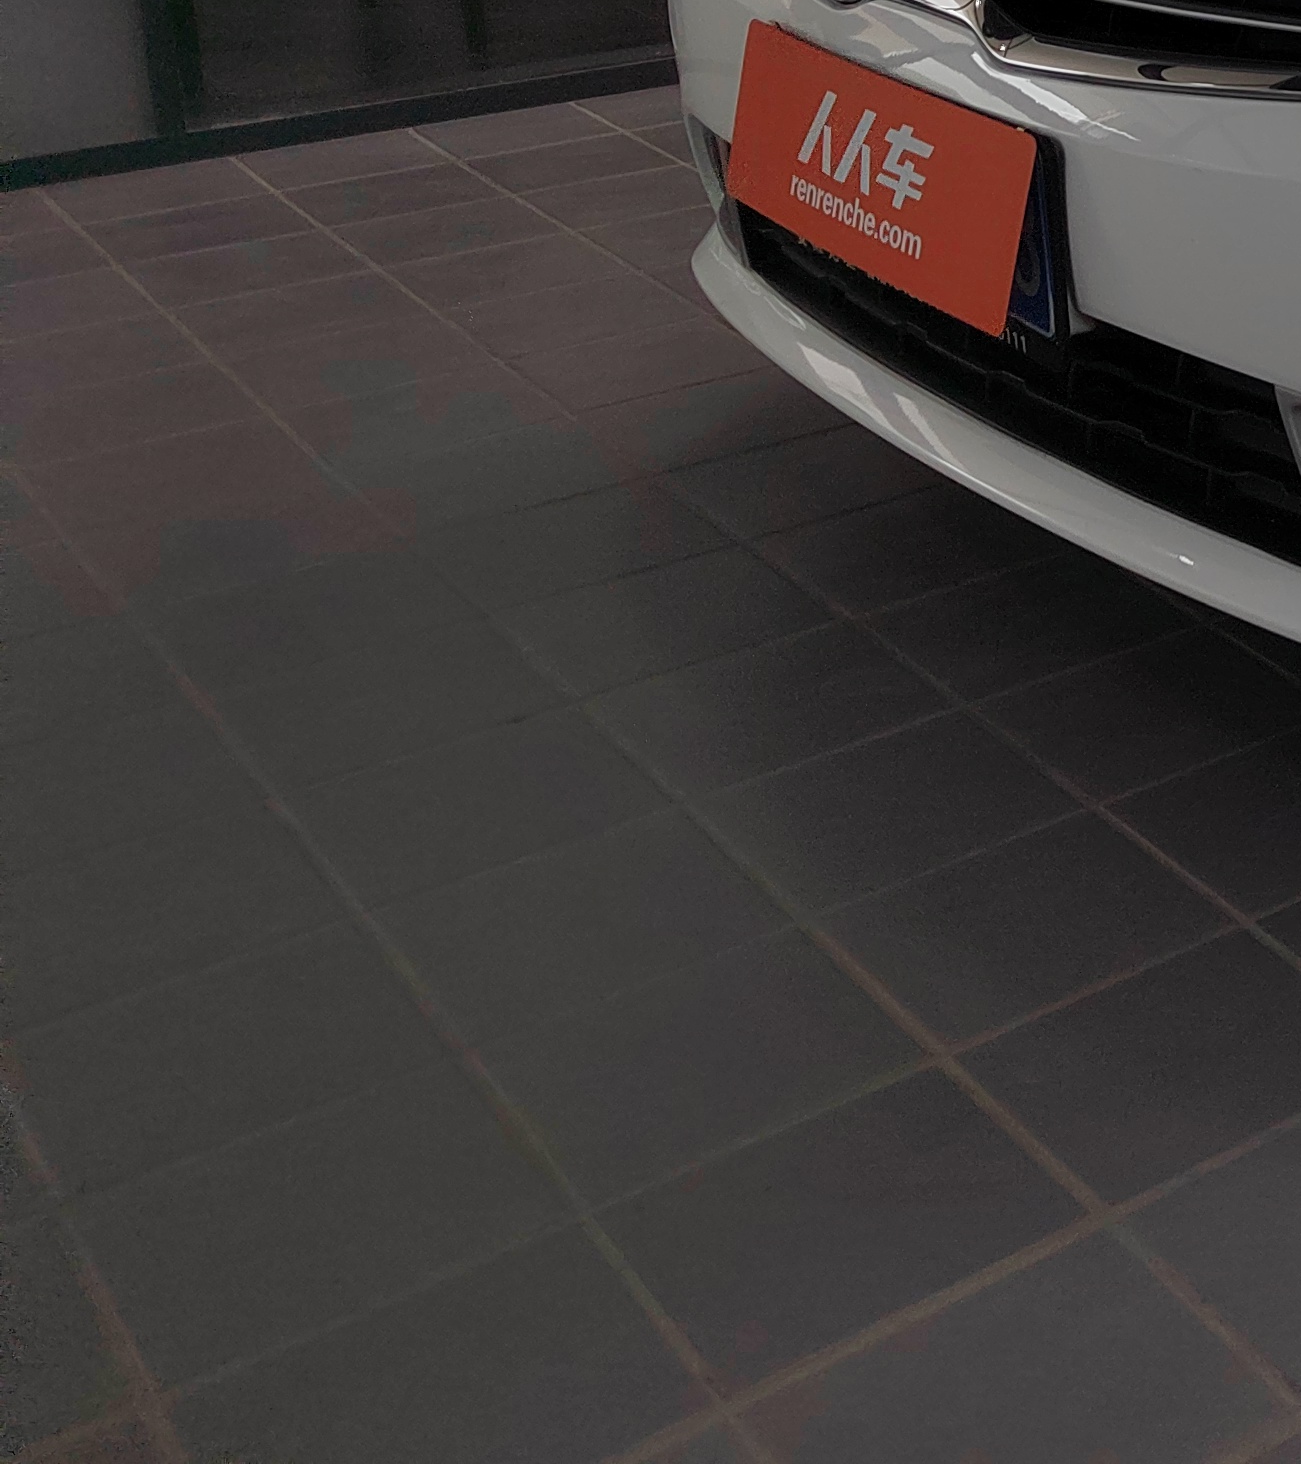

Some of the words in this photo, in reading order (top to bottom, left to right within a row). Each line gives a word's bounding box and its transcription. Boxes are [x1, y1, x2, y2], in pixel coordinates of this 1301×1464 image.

[798, 90, 935, 210] 人人车
[789, 173, 922, 260] renrenche.com
